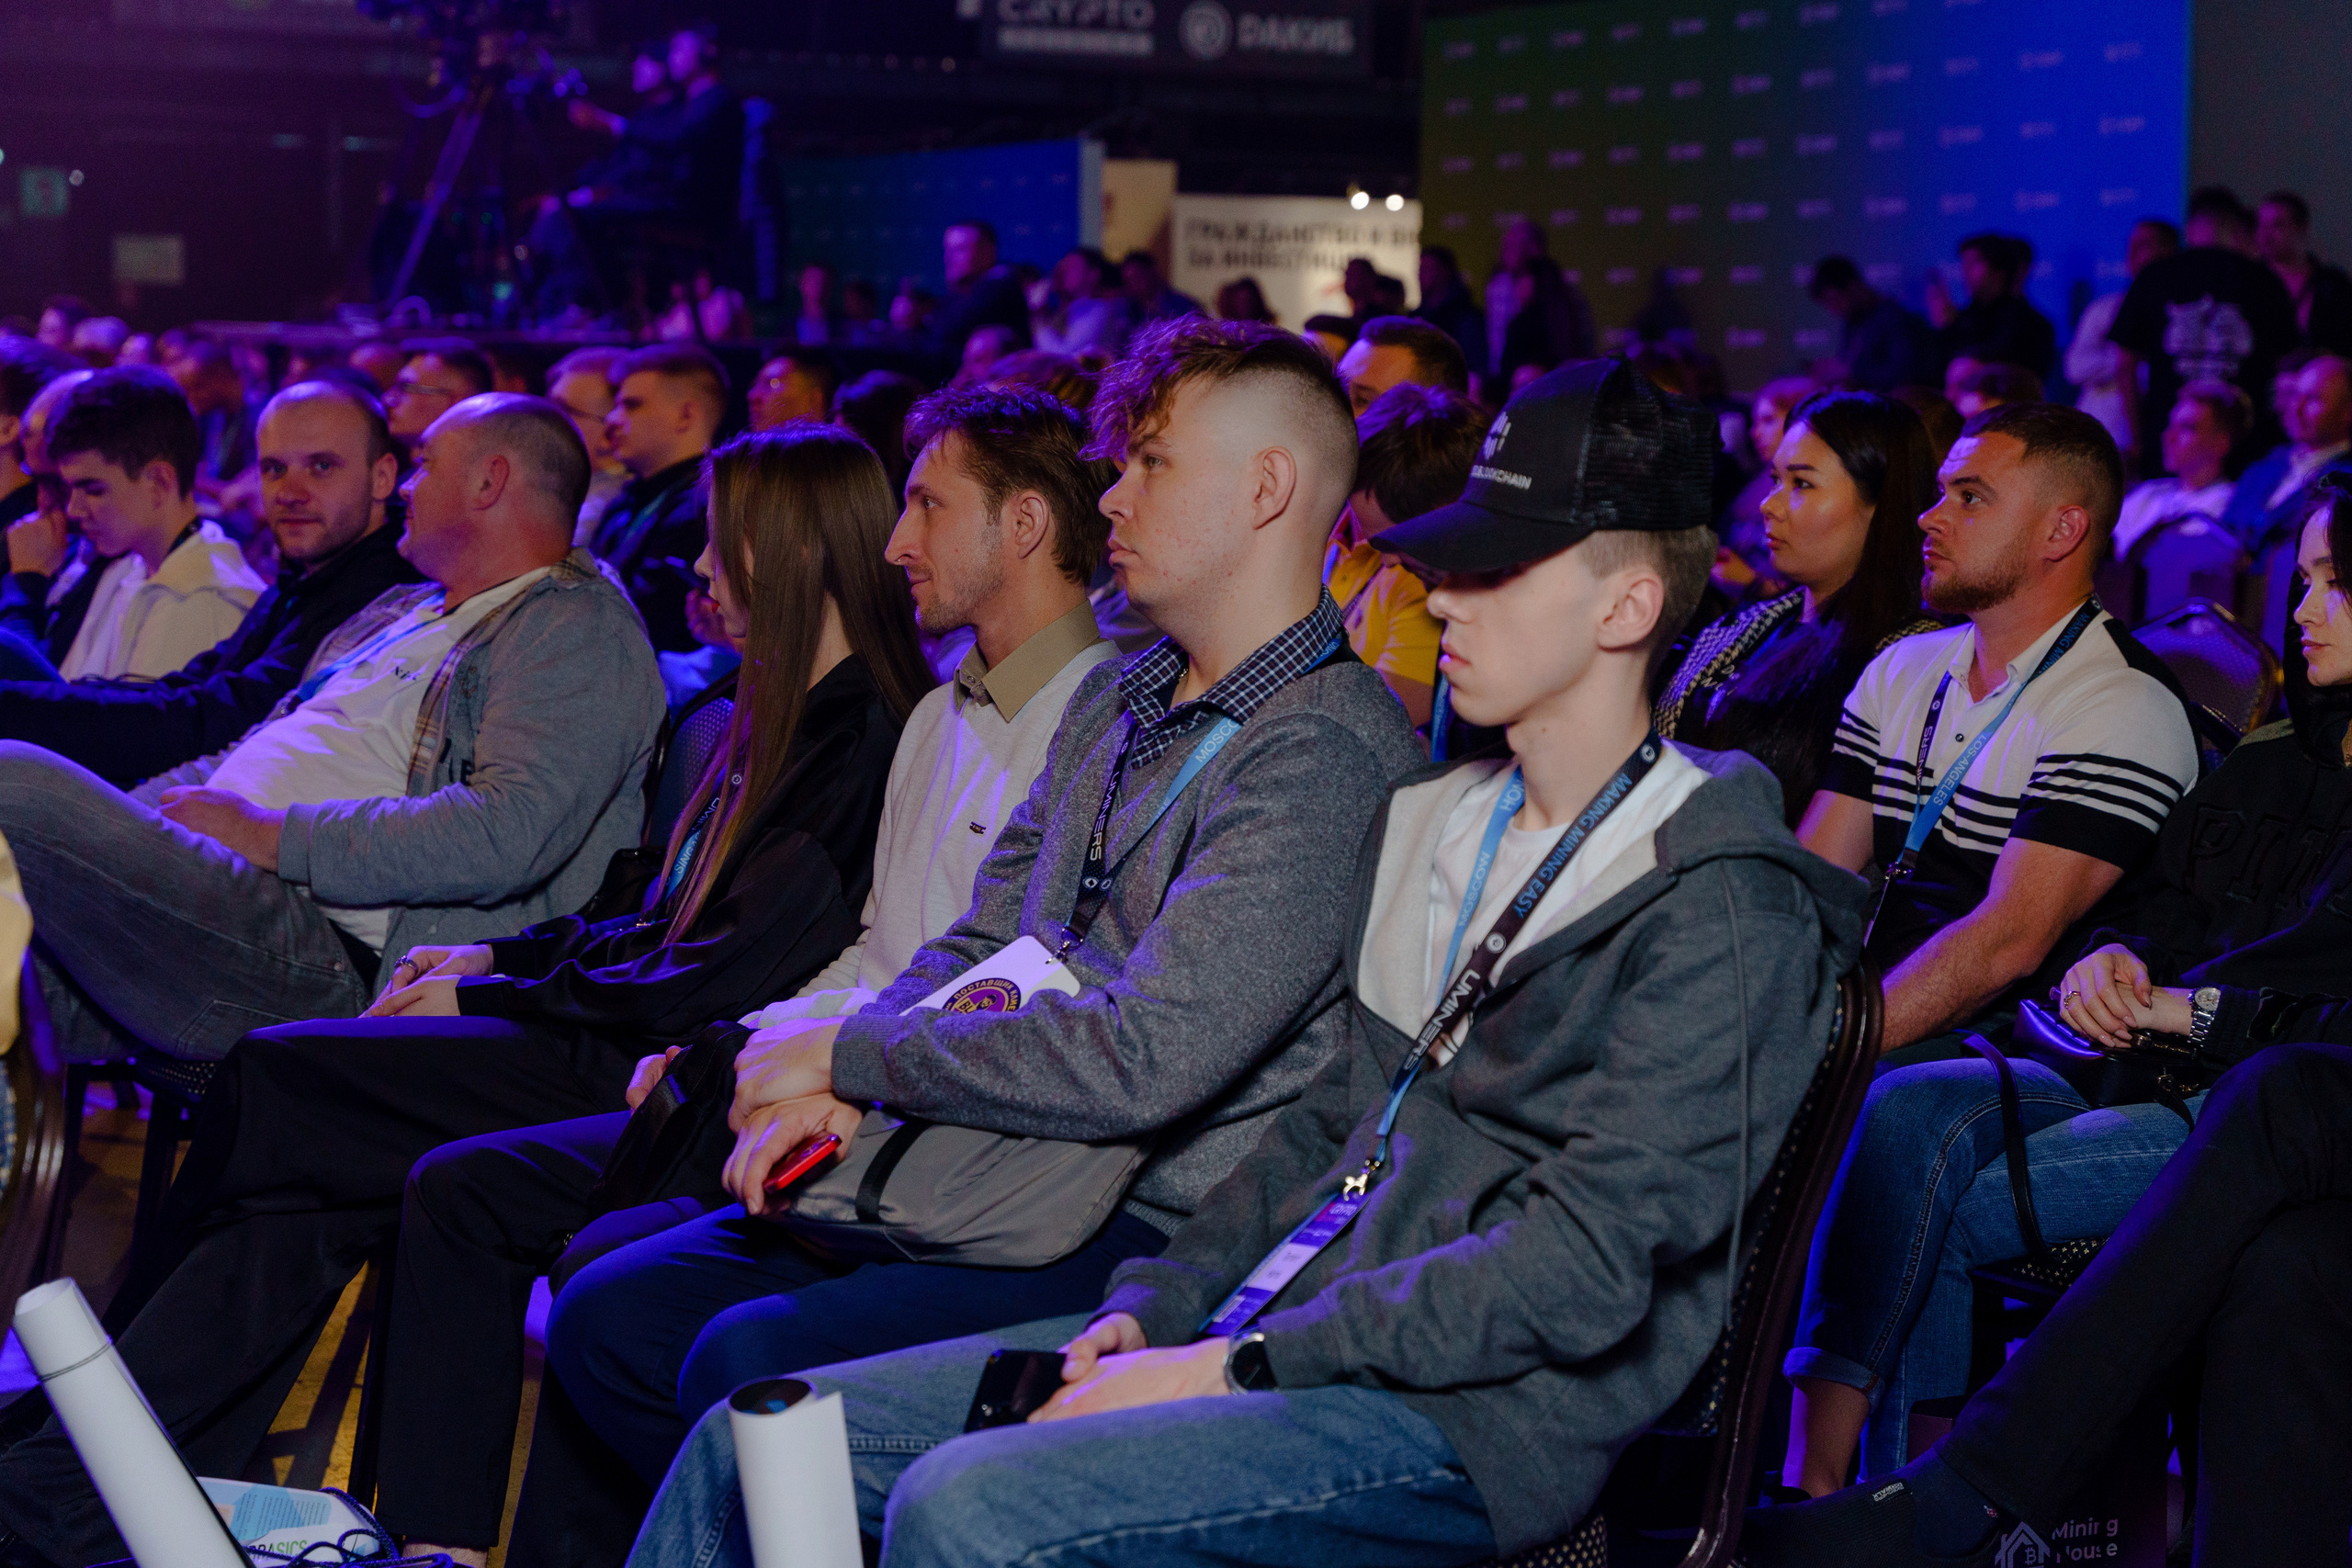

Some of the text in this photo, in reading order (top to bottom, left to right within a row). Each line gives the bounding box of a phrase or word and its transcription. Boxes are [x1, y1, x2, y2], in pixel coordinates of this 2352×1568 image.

[2038, 612, 2090, 674] MAKING MINI
[1933, 734, 1987, 807] LOS-ANGELES
[1512, 772, 1633, 919] MAKING MINING EASY
[1459, 852, 1490, 927] MOSCOW
[954, 979, 1014, 999] ПОСТАВЩИК
